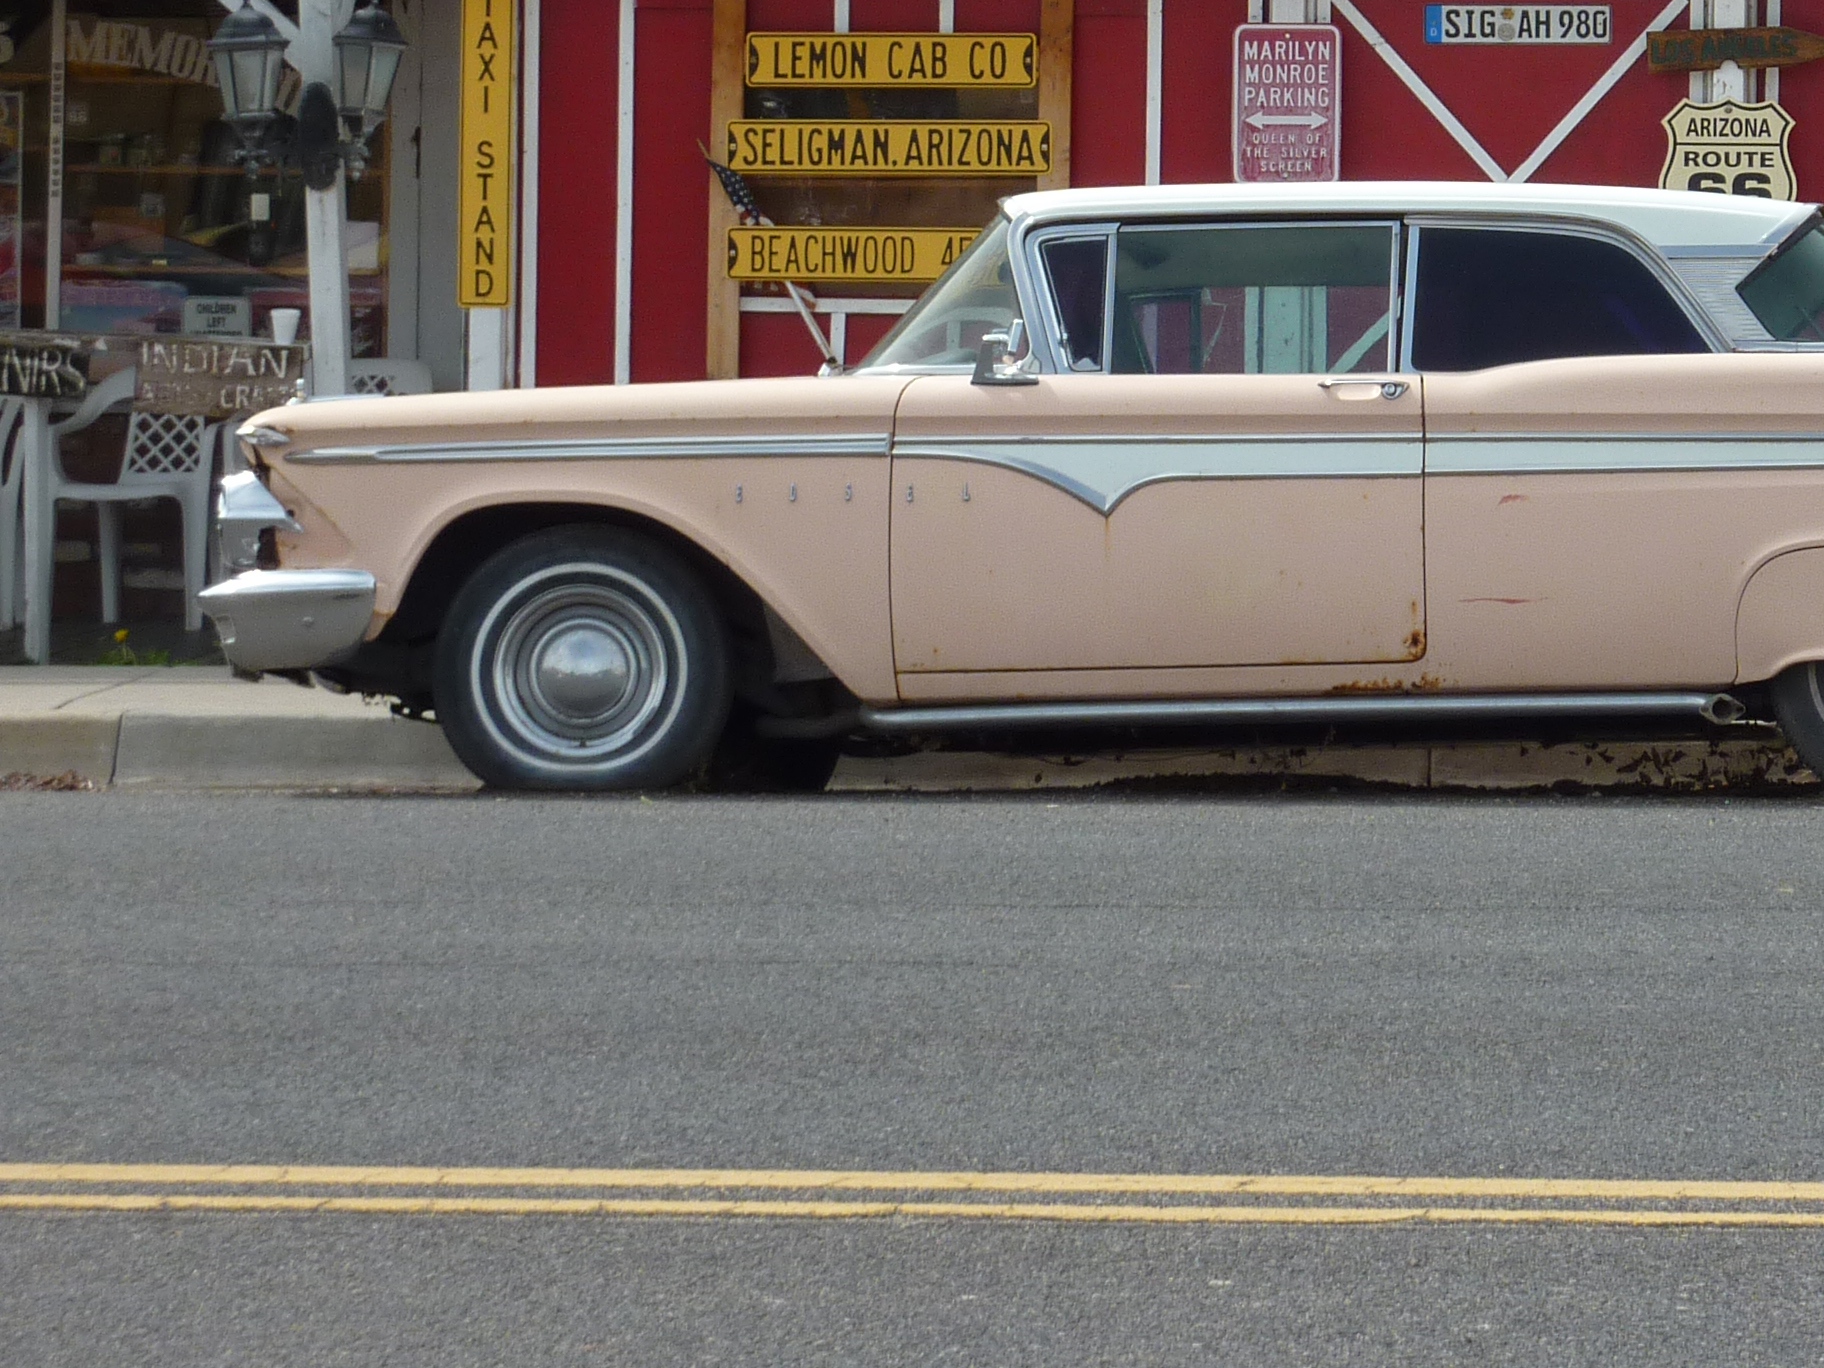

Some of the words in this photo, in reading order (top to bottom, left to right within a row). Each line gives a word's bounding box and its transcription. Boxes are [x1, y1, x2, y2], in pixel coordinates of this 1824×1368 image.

[1444, 9, 1496, 39] SIG
[1517, 10, 1551, 39] AH
[1558, 9, 1608, 39] 980
[773, 41, 867, 79] LEMON
[887, 41, 948, 79] CAB
[968, 41, 1008, 79] CO
[1243, 40, 1330, 61] MARILYN
[1650, 38, 1696, 64] LOS
[1244, 64, 1329, 84] MONROE
[1243, 87, 1329, 107] PARKING
[1686, 117, 1771, 138] ARIZONA
[742, 128, 898, 168] SELIGMAN,
[904, 128, 1036, 167] ARIZONA
[1252, 133, 1295, 144] QUEEN
[1306, 134, 1321, 144] OF
[1245, 147, 1270, 158] THE
[1281, 147, 1328, 158] SILVER
[1683, 151, 1775, 168] ROUTE
[1260, 161, 1313, 172] SCREEN
[474, 140, 496, 298] STAND
[751, 234, 915, 274] BEACHWOOD
[140, 340, 289, 379] INDIAN
